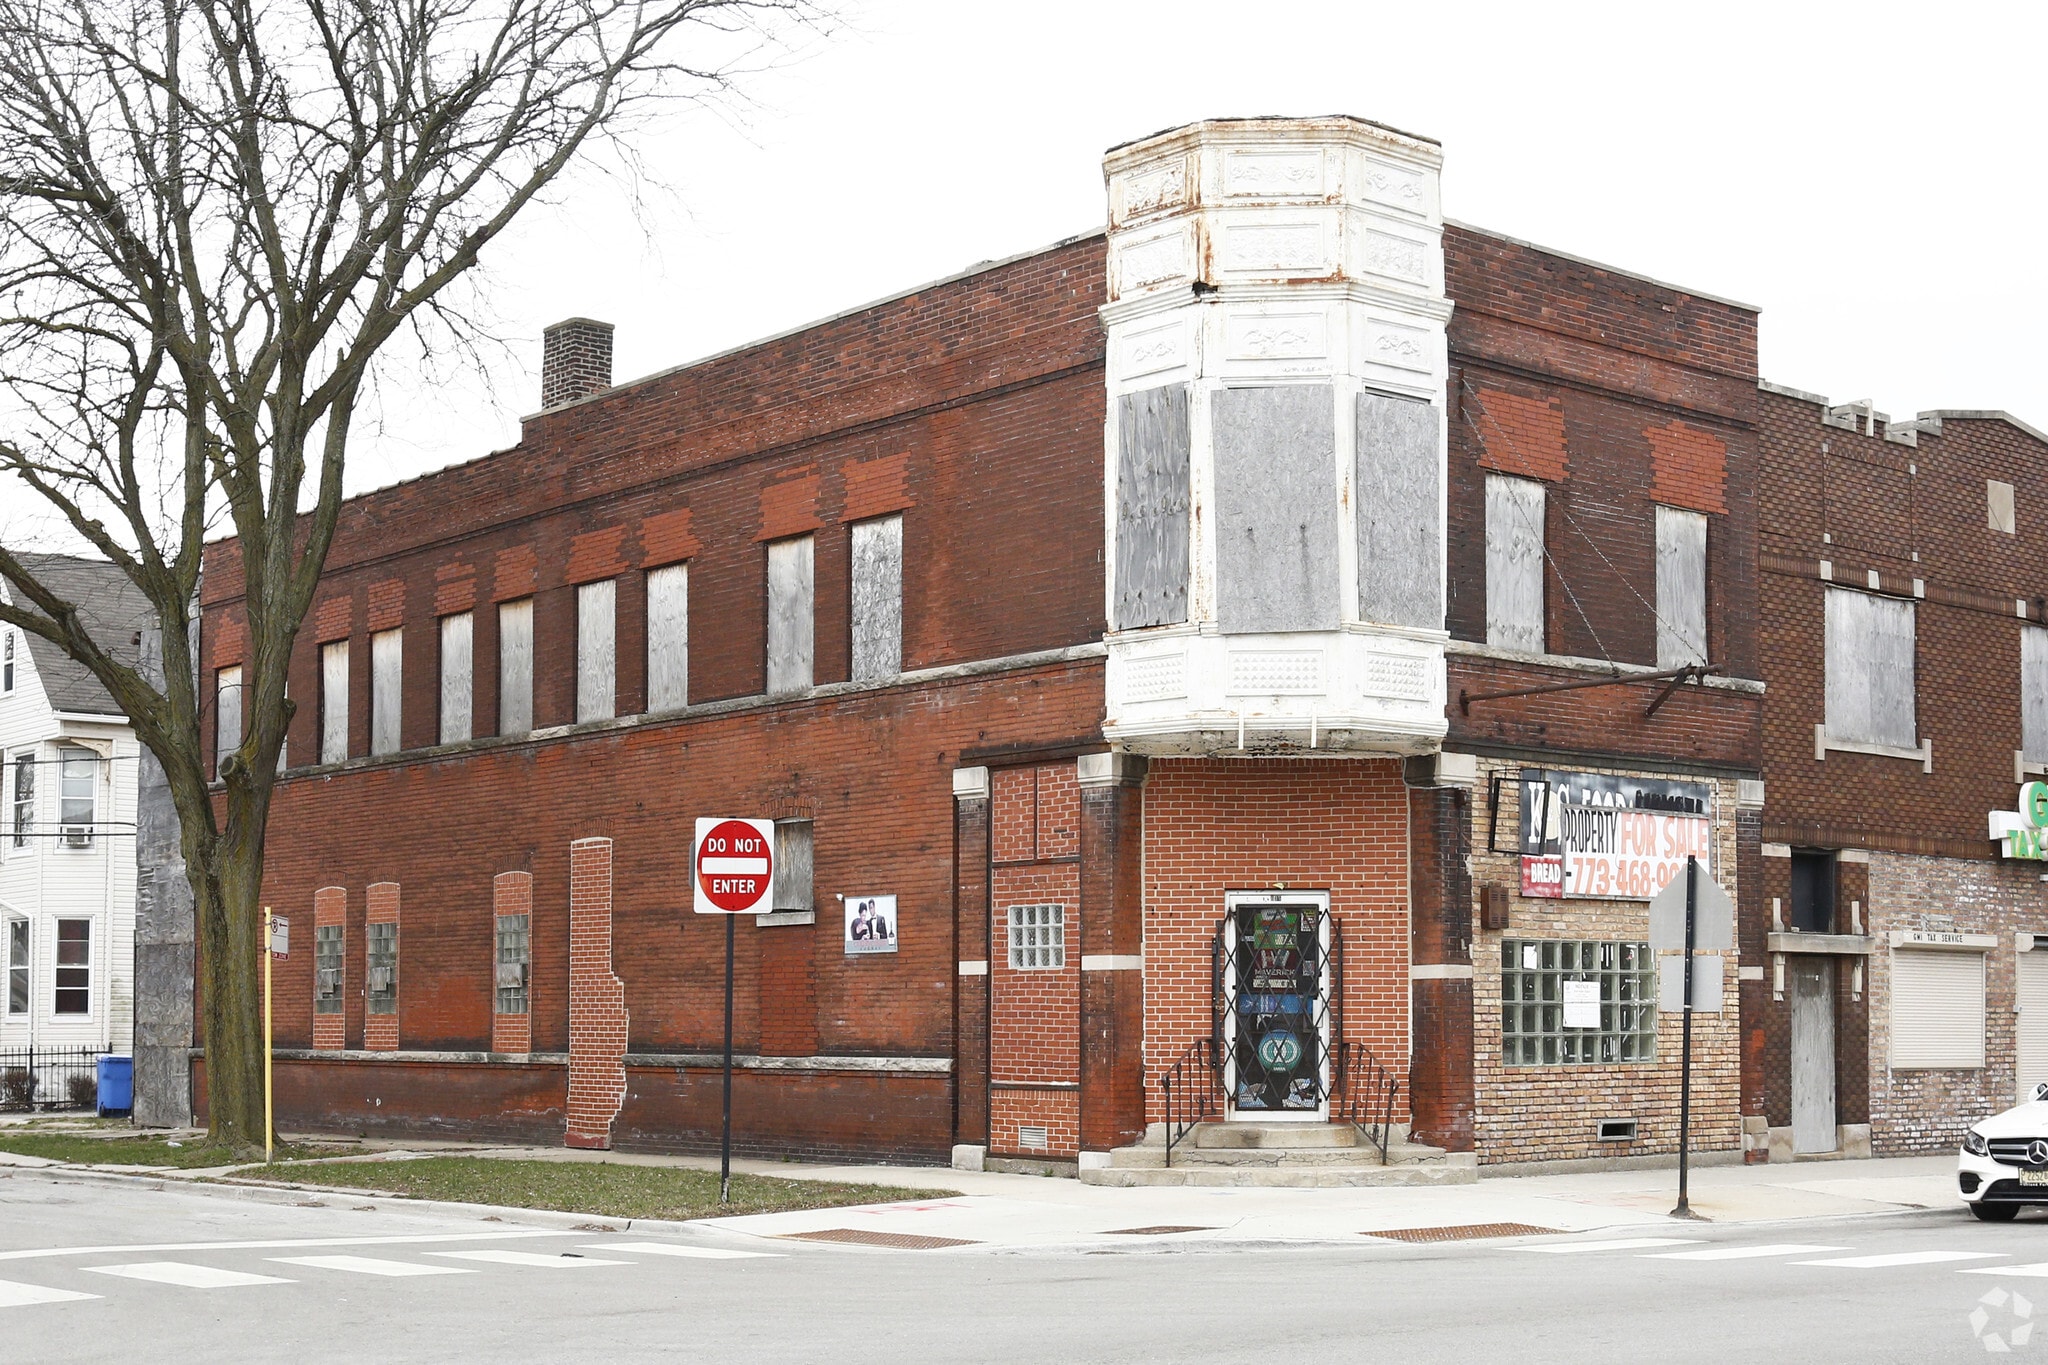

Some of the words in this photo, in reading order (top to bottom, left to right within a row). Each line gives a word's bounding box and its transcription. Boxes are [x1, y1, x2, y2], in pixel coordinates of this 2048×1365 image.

[1564, 808, 1617, 854] PROPERTY
[1620, 812, 1657, 857] FOR
[1663, 816, 1708, 859] SALE
[708, 838, 726, 853] DO
[735, 838, 762, 853] NOT
[2007, 829, 2044, 859] TAX
[1530, 862, 1561, 884] BREAD
[1573, 857, 1688, 897] 773-468-9
[713, 879, 756, 894] ENTER
[1927, 933, 1937, 942] TAX
[1941, 934, 1964, 943] SERVICE
[1254, 968, 1296, 976] MAVERICK
